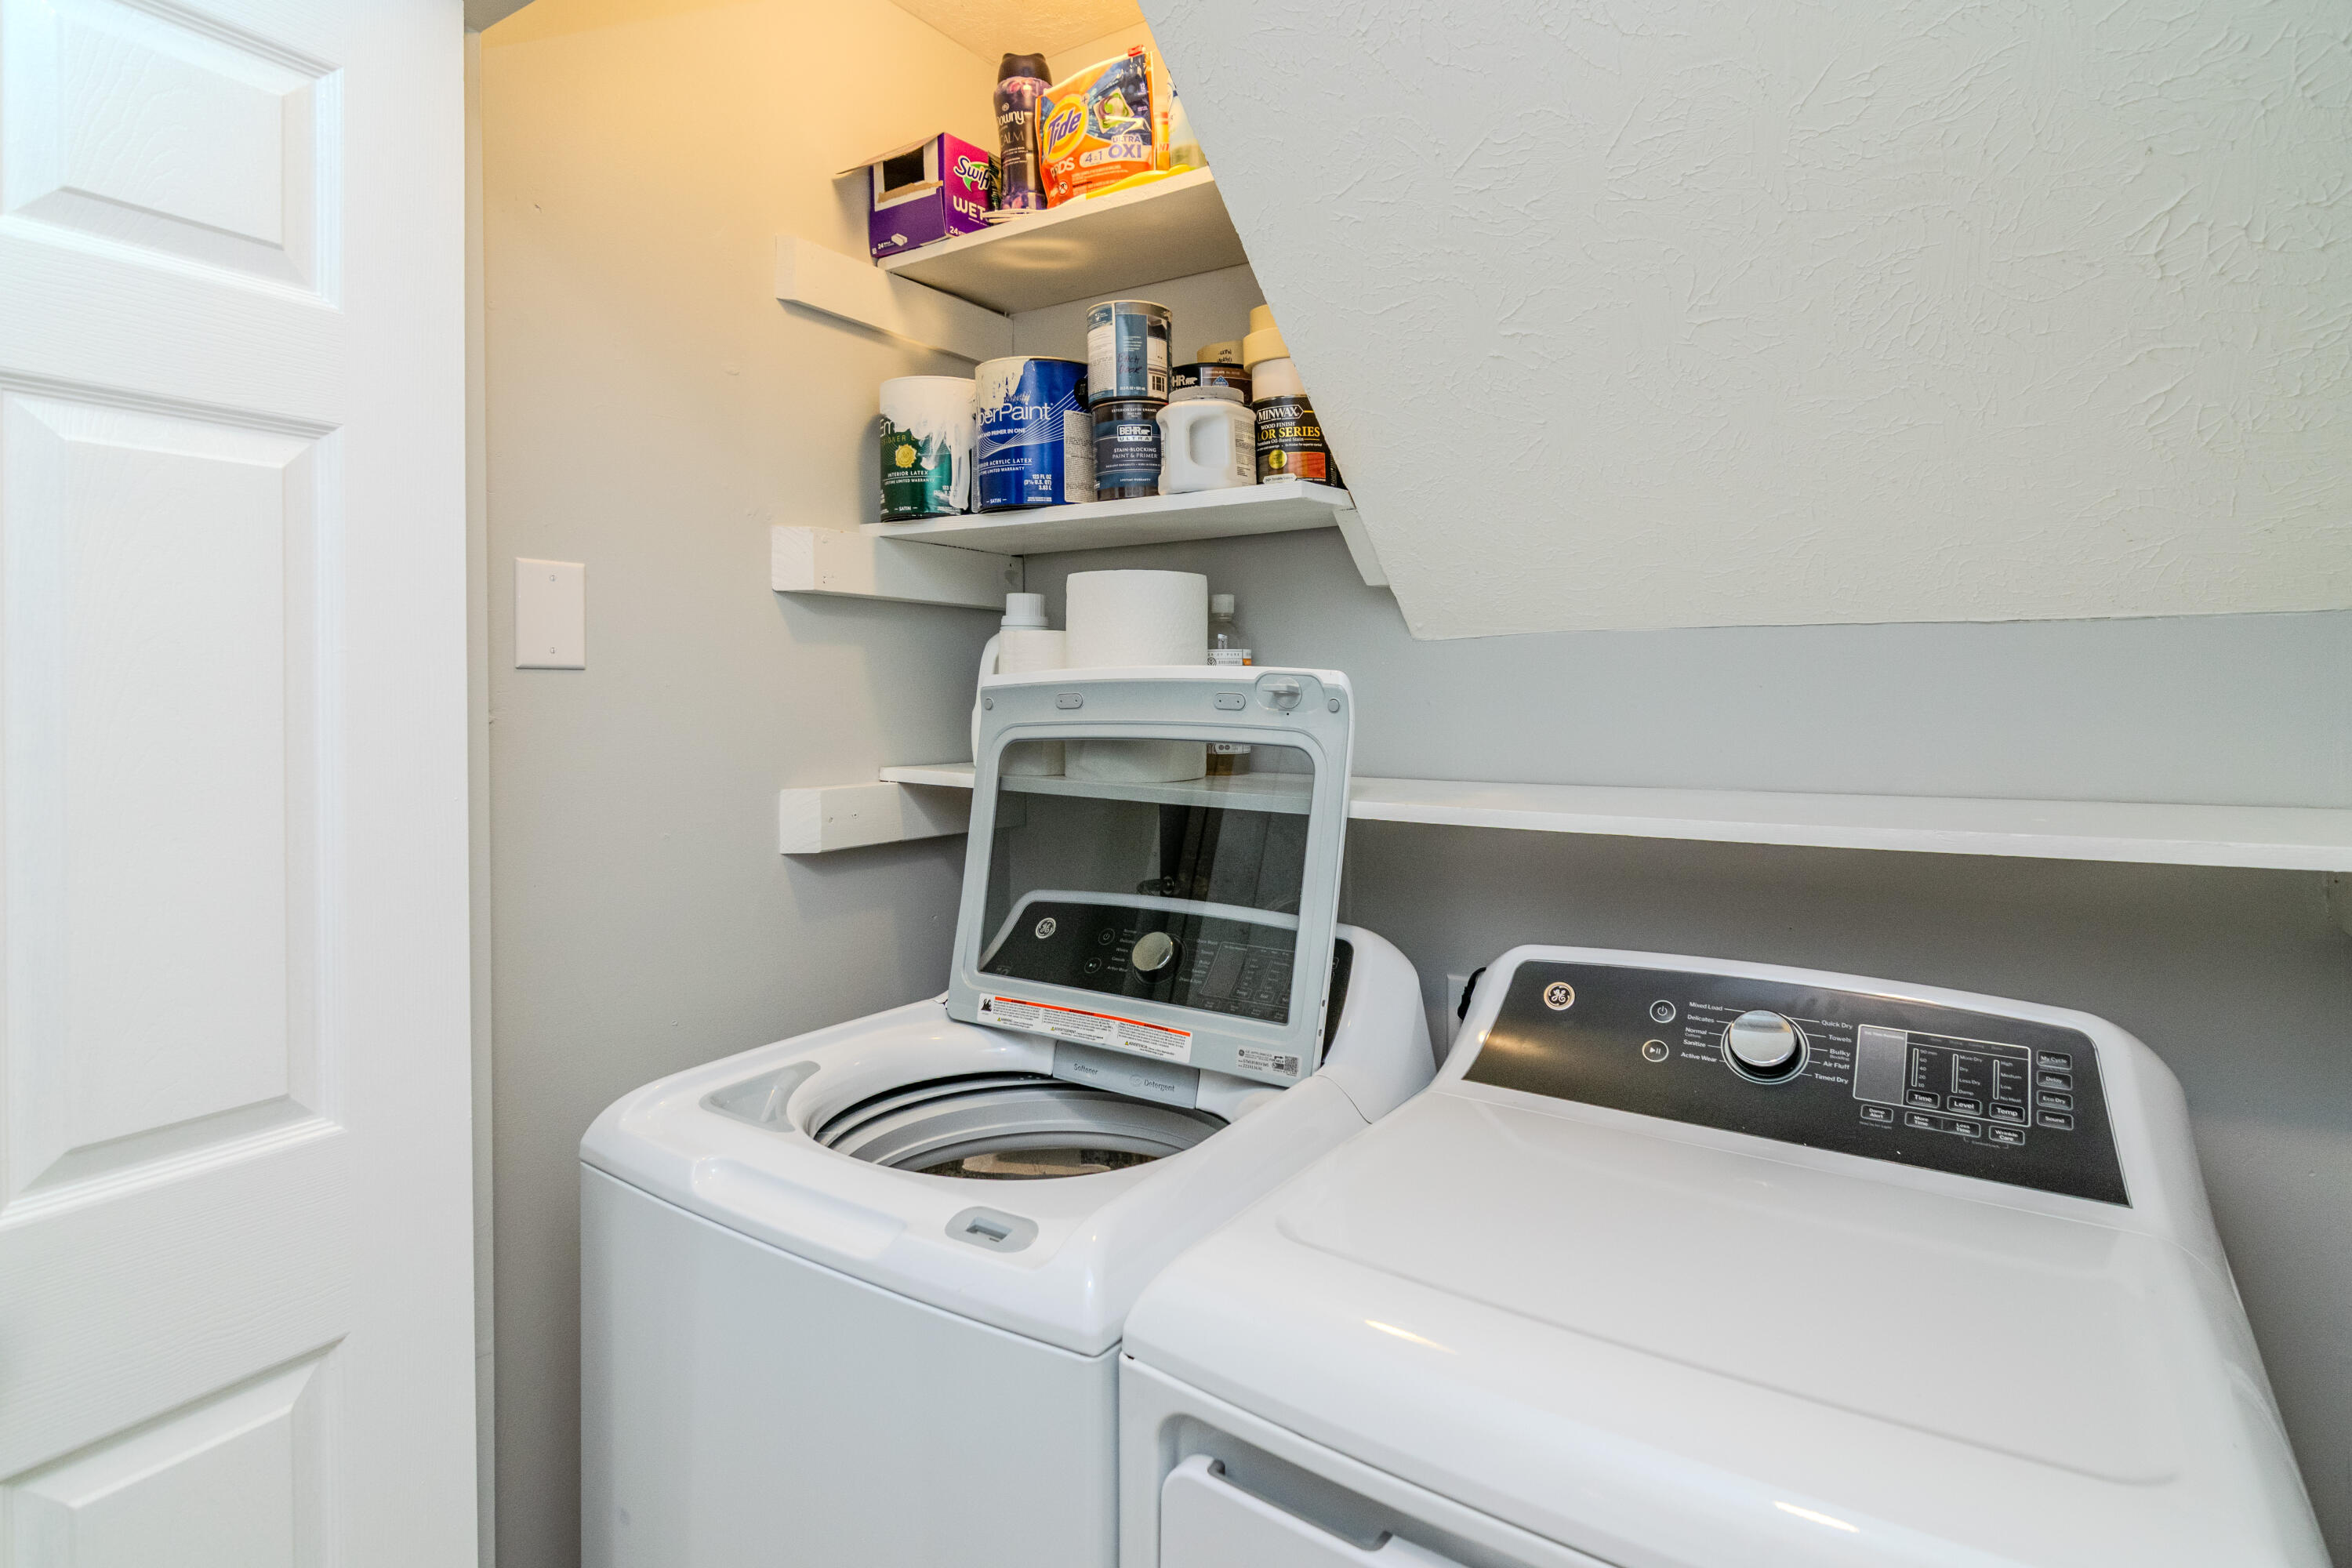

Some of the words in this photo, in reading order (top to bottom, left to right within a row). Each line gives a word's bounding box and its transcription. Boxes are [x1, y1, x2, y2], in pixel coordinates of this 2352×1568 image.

[1047, 107, 1082, 154] Tide
[1112, 135, 1141, 143] ULTRA
[1109, 144, 1142, 158] OXI
[1085, 153, 1092, 163] 4
[949, 226, 958, 234] 24
[1172, 374, 1185, 387] HR
[978, 402, 1051, 426] perPaint
[1258, 406, 1298, 422] MINWAX
[1119, 426, 1141, 436] BEHR
[1258, 429, 1277, 442] LOR
[1279, 426, 1320, 437] SERIES
[1689, 1001, 1707, 1010] Mixed
[1687, 1014, 1715, 1023] Delicates
[1683, 1039, 1706, 1047] Sanitize
[1828, 1034, 1852, 1043] Towels
[1681, 1051, 1700, 1061] Active
[1829, 1048, 1850, 1058] Bulky
[1073, 1063, 1098, 1076] Softener
[1814, 1073, 1835, 1082] Timed
[1144, 1079, 1175, 1092] Detergent
[1914, 1094, 1933, 1102] Time
[1954, 1101, 1975, 1110] Level
[1996, 1107, 2018, 1117] Temp
[1995, 1129, 2019, 1138] Wrinkle
